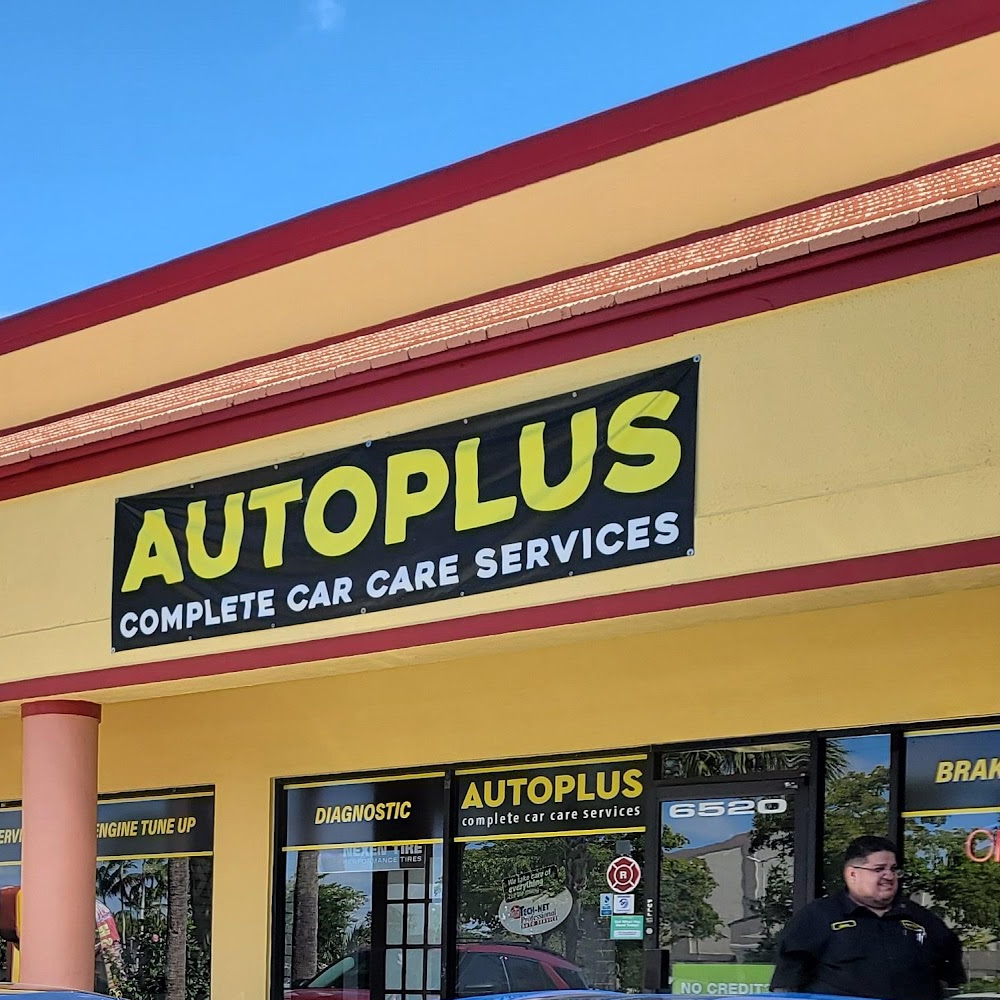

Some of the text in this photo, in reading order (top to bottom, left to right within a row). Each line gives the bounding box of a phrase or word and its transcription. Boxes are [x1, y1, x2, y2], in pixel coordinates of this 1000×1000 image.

[121, 390, 682, 592] AUTOPLUS
[119, 511, 680, 638] COMPLETE CAR CARE SERVICES
[935, 758, 1000, 783] BRAK
[461, 768, 643, 809] AUTOPLUS
[314, 801, 412, 825] DIAGNOSTIC
[461, 805, 641, 828] complete car care services
[669, 798, 787, 819] 6520
[141, 817, 175, 836] TUNE
[177, 816, 197, 834] UP
[400, 855, 423, 863] TIRES
[619, 870, 628, 880] R
[680, 981, 703, 995] NO
